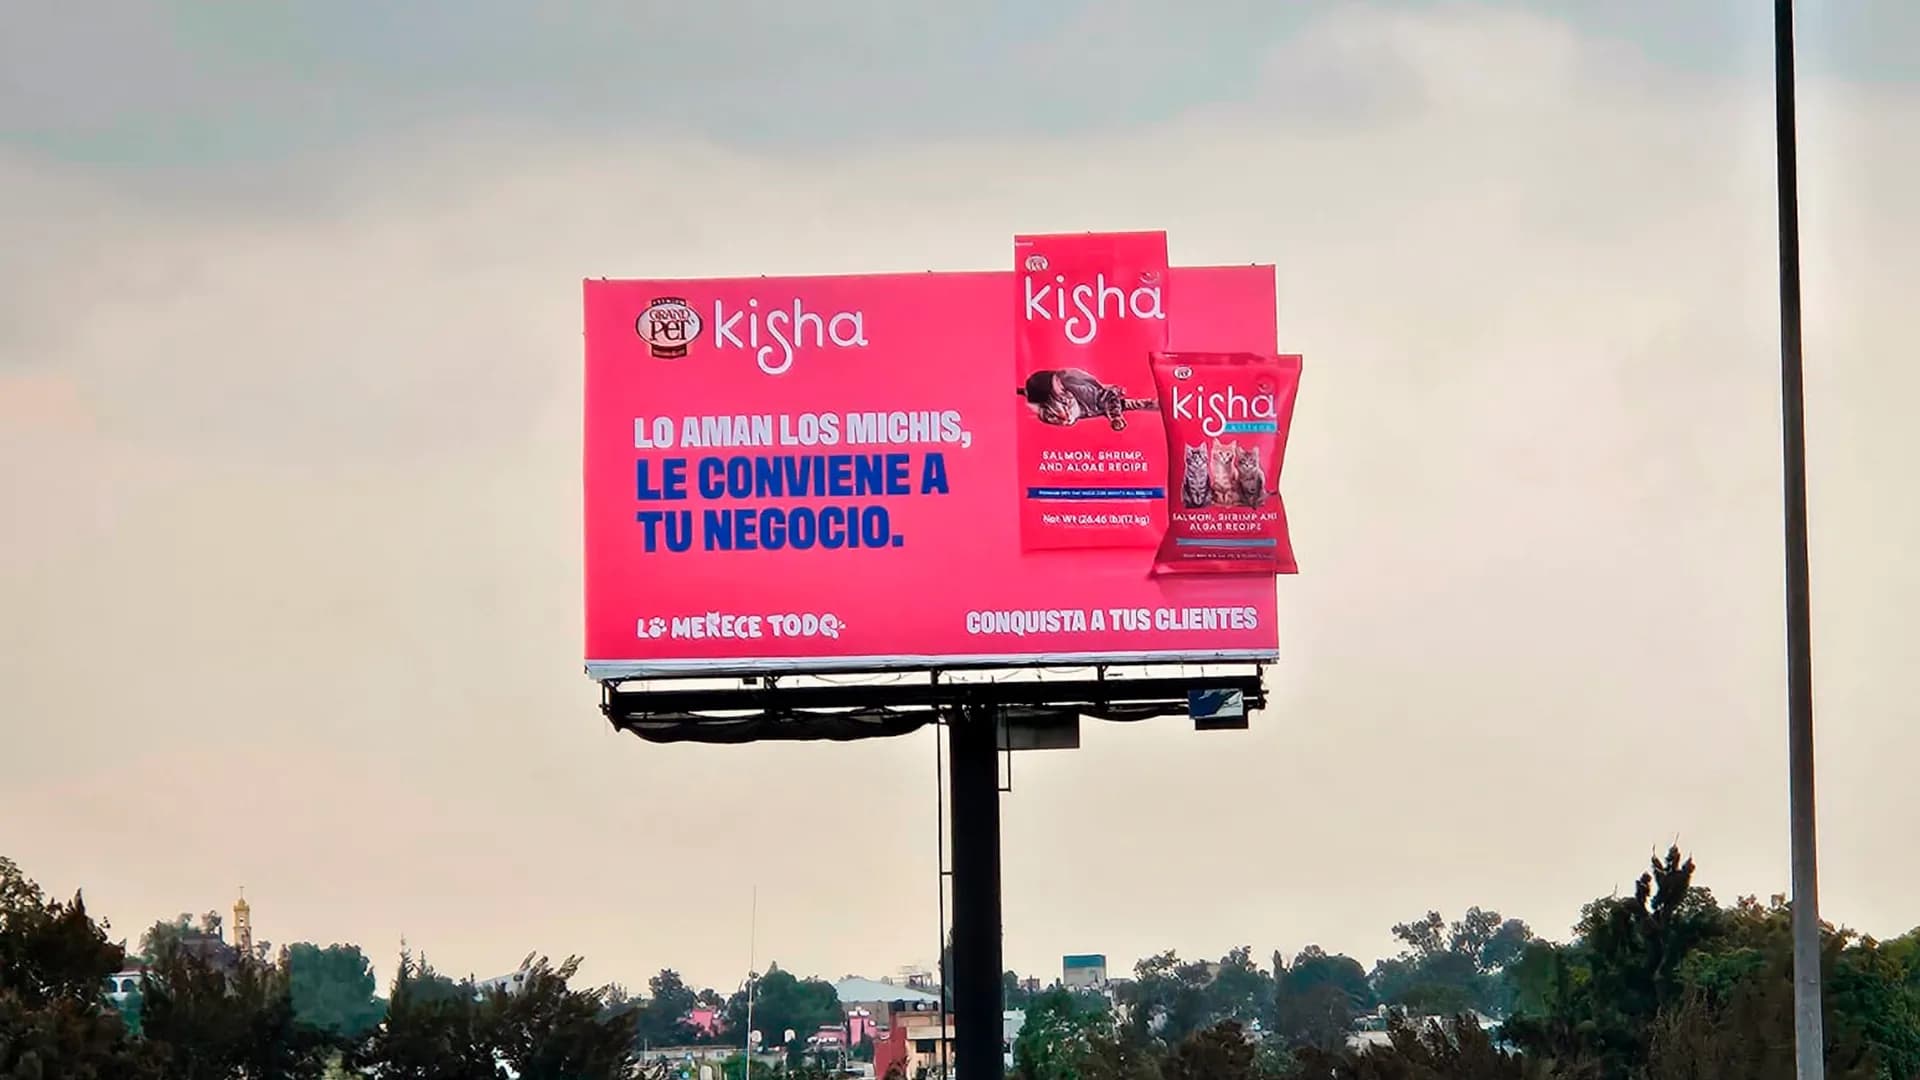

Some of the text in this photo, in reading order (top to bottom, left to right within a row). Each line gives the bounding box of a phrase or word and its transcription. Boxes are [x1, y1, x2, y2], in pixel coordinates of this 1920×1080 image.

[1025, 273, 1165, 345] kisha
[714, 298, 868, 375] kisha
[634, 410, 972, 448] LO AMAN LOS MICHIS,
[1172, 385, 1277, 437] kisha
[636, 452, 949, 501] LE CONVIENE A
[1039, 462, 1148, 472] AND ALGAE RECIPE
[1043, 451, 1094, 461] SALMON,
[636, 505, 904, 553] TU NEGOCIO.
[671, 610, 763, 640] MERECE
[966, 607, 1259, 637] CONQUISTA A TUS CLIENTES
